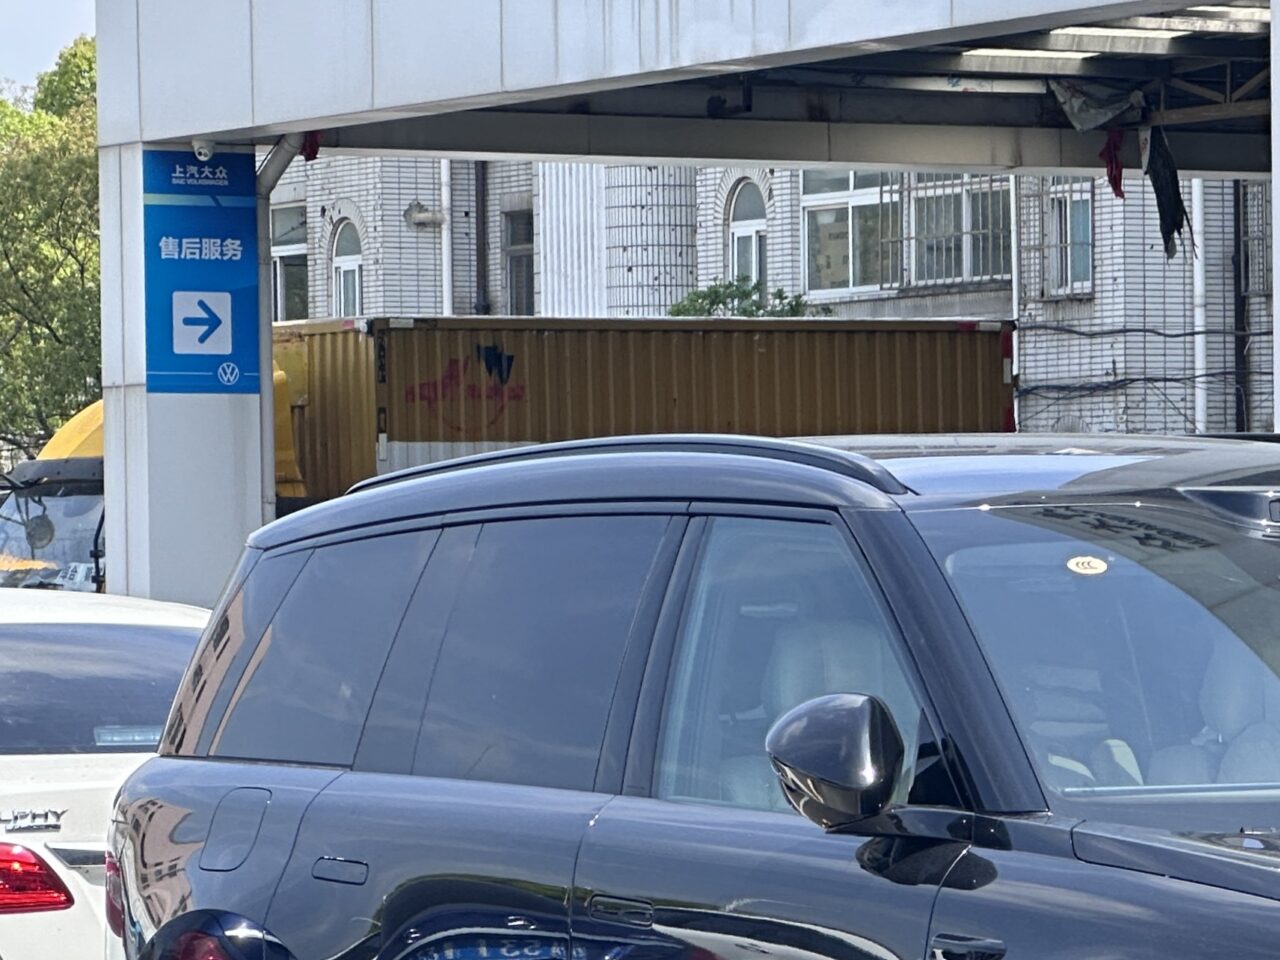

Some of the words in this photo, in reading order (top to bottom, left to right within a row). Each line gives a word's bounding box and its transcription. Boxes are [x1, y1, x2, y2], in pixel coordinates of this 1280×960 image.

[171, 164, 228, 178] 上汽大众
[158, 236, 243, 260] 售后服务
